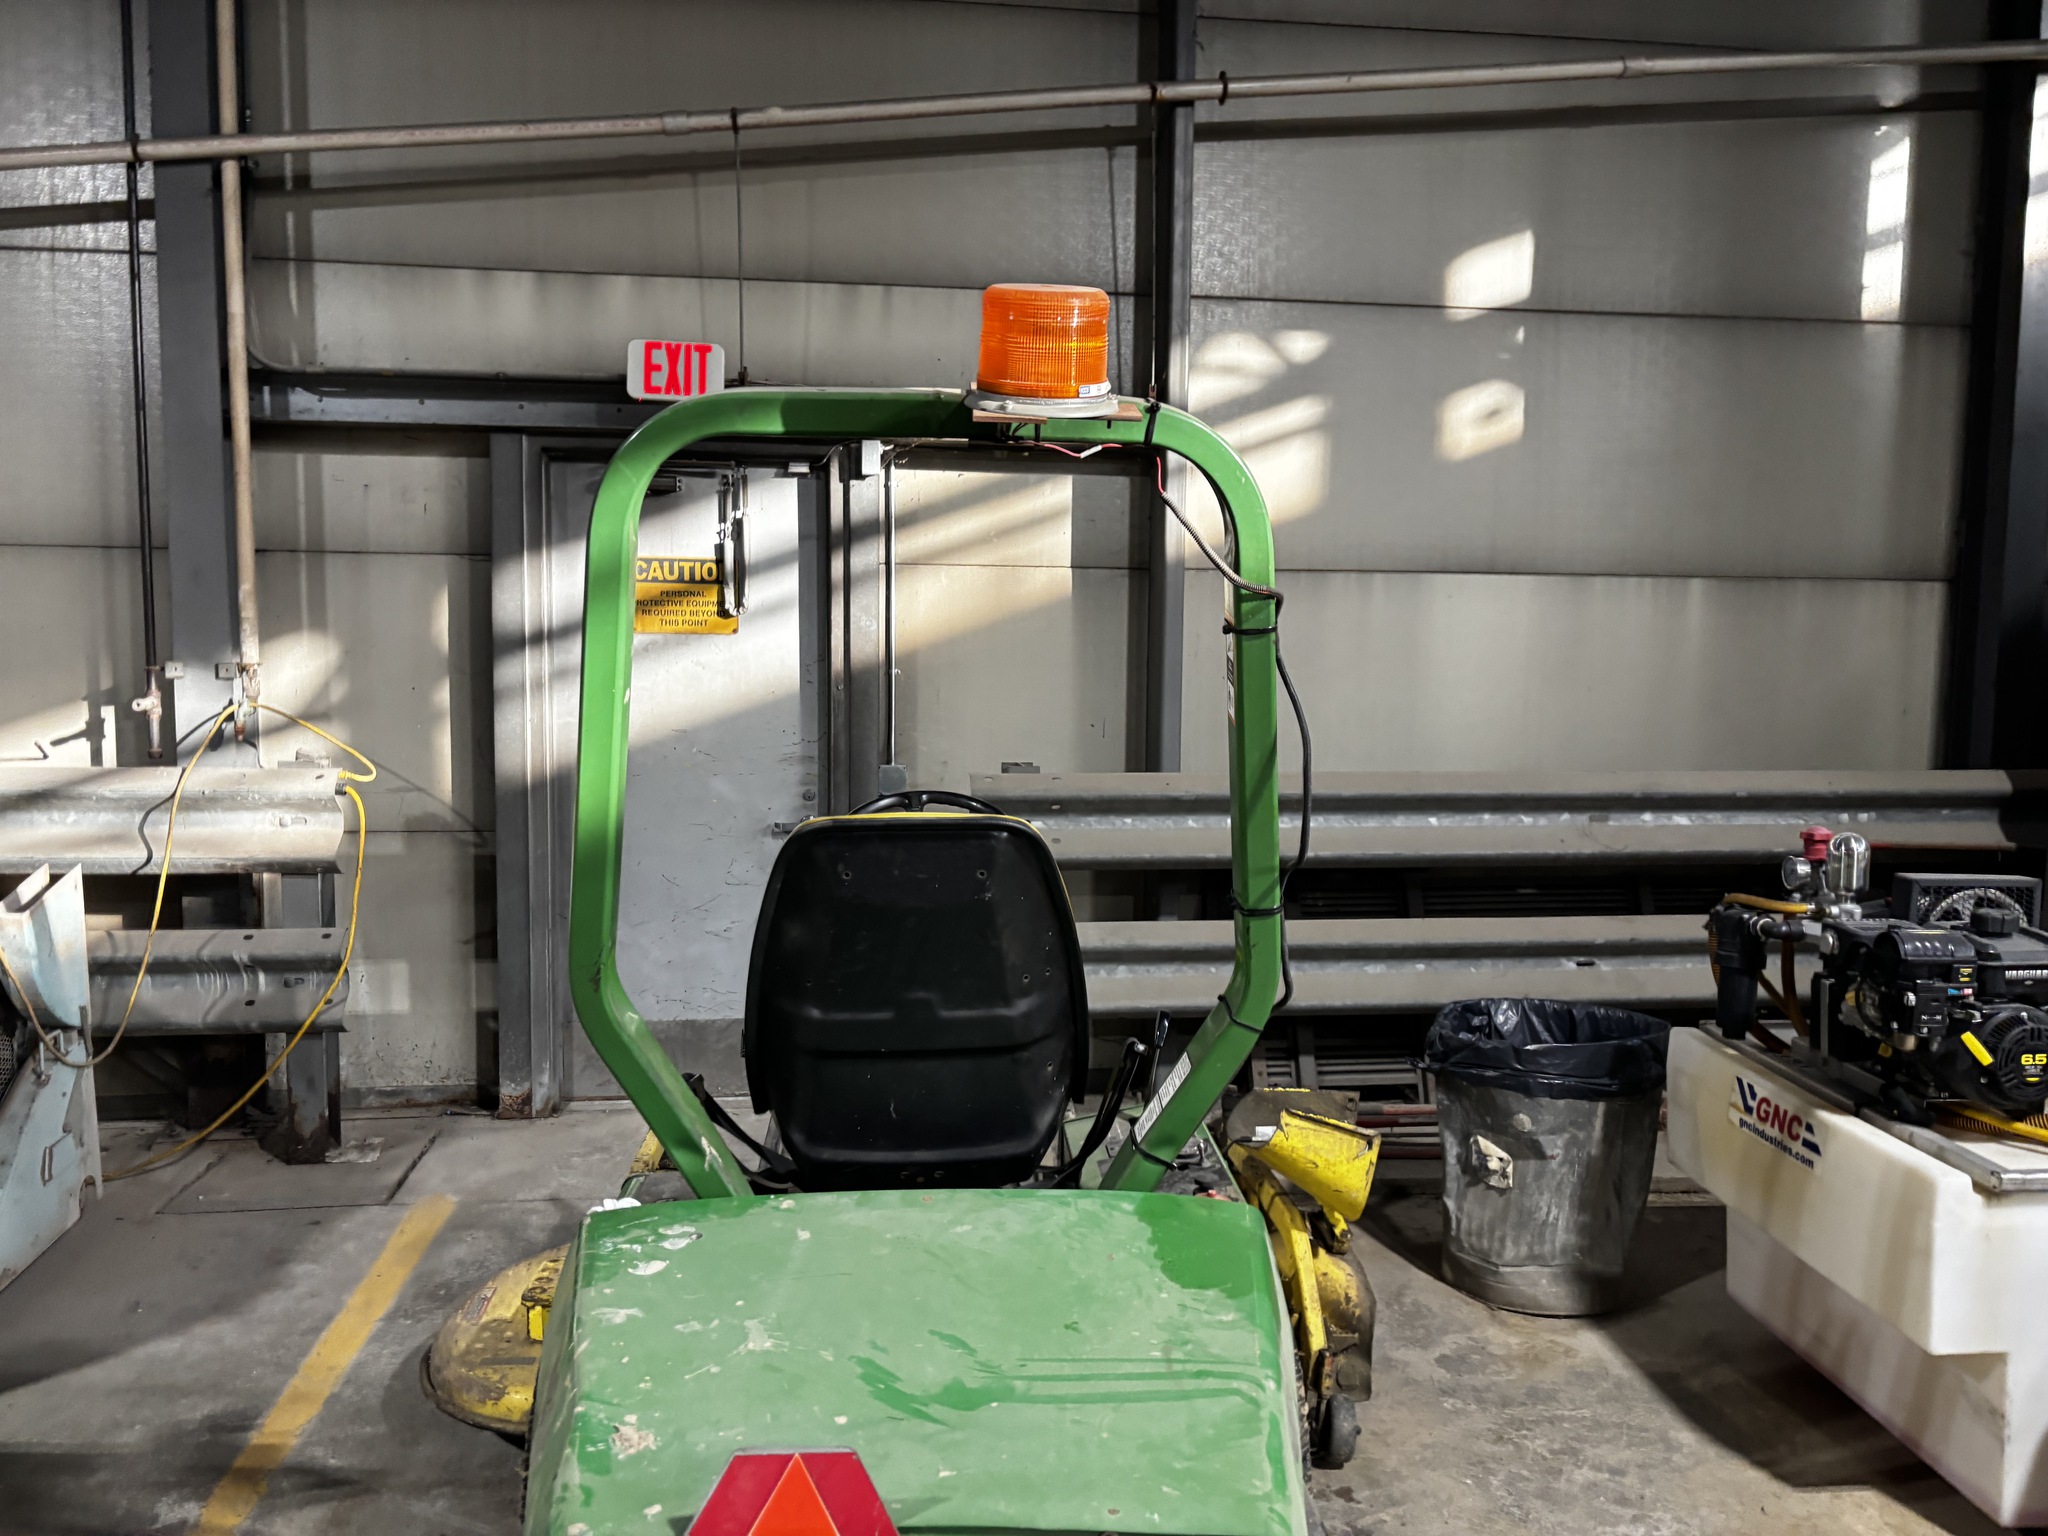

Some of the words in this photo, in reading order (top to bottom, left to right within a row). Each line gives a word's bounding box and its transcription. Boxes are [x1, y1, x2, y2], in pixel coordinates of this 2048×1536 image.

[643, 341, 712, 396] EXIT
[660, 590, 706, 598] PERSONAL
[636, 599, 684, 608] ROTECTIVE
[686, 600, 725, 608] EQUIPME
[641, 609, 687, 618] REQUIRED
[689, 609, 726, 618] BEYOND
[659, 618, 680, 627] THIS
[681, 619, 708, 627] POINT
[2005, 970, 2048, 979] VANGUAR
[2021, 1054, 2047, 1065] 6.5
[1756, 1097, 1803, 1142] GNC
[1739, 1117, 1814, 1170] gncindustries.com
